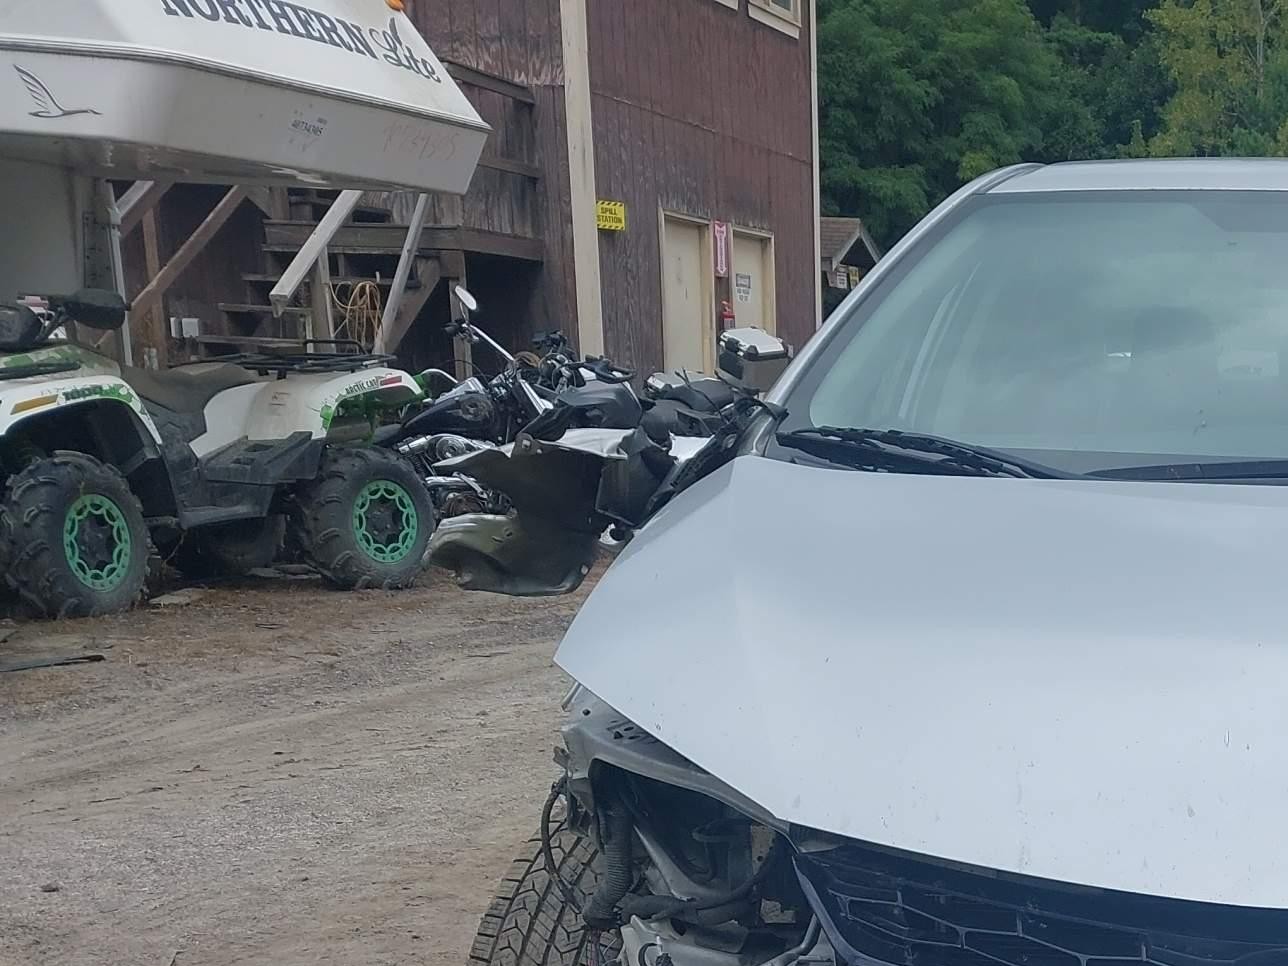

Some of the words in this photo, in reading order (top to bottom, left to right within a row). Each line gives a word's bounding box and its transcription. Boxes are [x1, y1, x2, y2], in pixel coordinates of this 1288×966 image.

[368, 17, 442, 84] Lite
[600, 206, 617, 216] SPILL
[597, 214, 623, 224] STATION
